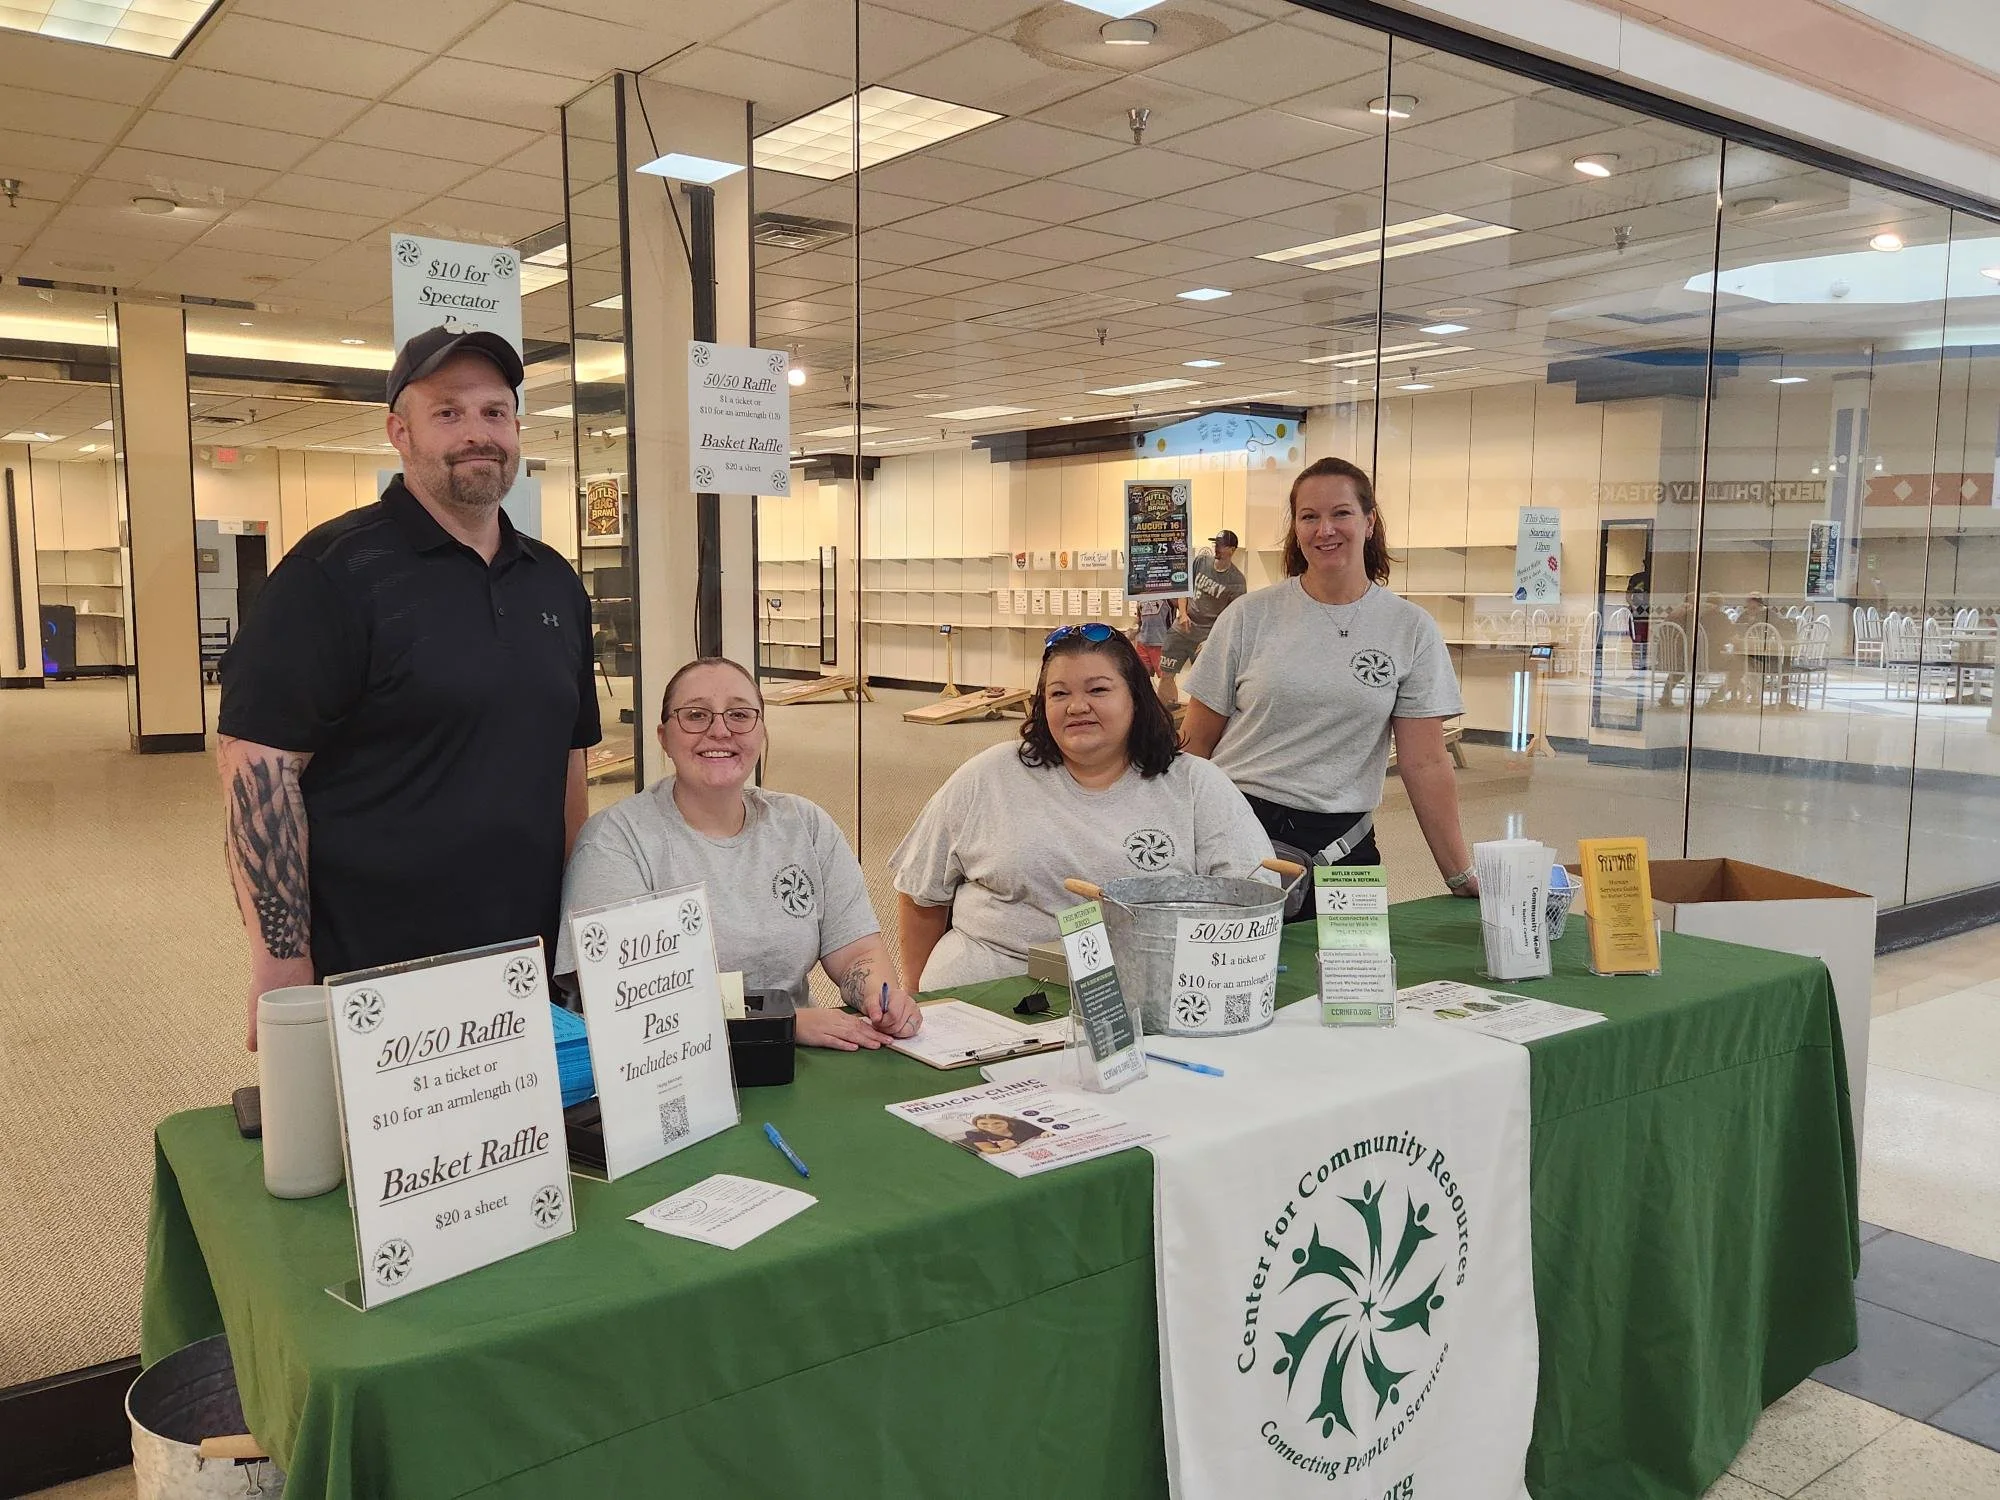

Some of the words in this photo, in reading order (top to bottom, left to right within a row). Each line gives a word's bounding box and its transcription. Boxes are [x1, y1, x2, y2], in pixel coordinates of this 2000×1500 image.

[428, 259, 461, 279] $10
[464, 265, 490, 282] for
[419, 286, 499, 309] Spectator
[704, 373, 740, 388] 50/50
[742, 376, 777, 392] Raffle
[720, 395, 728, 404] $1
[735, 397, 753, 406] ticket
[700, 406, 712, 414] $10
[714, 407, 723, 415] for
[735, 409, 767, 420] armlength
[701, 433, 745, 449] Basket
[749, 437, 783, 453] Raffle
[745, 464, 761, 472] sheet
[589, 487, 618, 505] BUTLER
[594, 498, 613, 510] BAG
[1145, 494, 1171, 503] BUTLER
[592, 508, 618, 519] BRAWL
[1156, 511, 1161, 520] 2
[1524, 513, 1538, 523] This
[601, 519, 607, 534] 2
[1136, 522, 1167, 530] AUGUST
[1170, 521, 1180, 529] 16
[1195, 572, 1226, 598] LUCKY
[1530, 886, 1540, 933] Community
[1190, 922, 1244, 943] 50/50
[1246, 915, 1280, 938] Raffle
[619, 933, 650, 966] $10
[655, 929, 680, 954] for
[1532, 934, 1541, 960] Meals
[1211, 952, 1226, 967] $1
[1237, 955, 1258, 965] ticket
[615, 968, 694, 1009] Spectator
[1178, 973, 1205, 988] $10
[1208, 980, 1221, 989] for
[1331, 1008, 1372, 1016] CCRINFO.ORG
[643, 1012, 679, 1039] Pass
[376, 1026, 450, 1068] 50/50
[456, 1011, 526, 1049] Raffle
[681, 1033, 712, 1061] Food
[413, 1075, 428, 1092] $1
[434, 1076, 442, 1087] a
[446, 1064, 481, 1083] ticket
[484, 1061, 498, 1072] or
[373, 1110, 399, 1131] $10
[403, 1106, 424, 1122] for
[427, 1102, 443, 1114] an
[447, 1082, 512, 1110] armlength
[515, 1072, 538, 1093] (13)
[906, 1093, 985, 1114] MEDICAL
[985, 1078, 1042, 1096] CLINIC
[381, 1152, 472, 1201] Basket
[478, 1126, 549, 1169] Raffle
[435, 1208, 460, 1230] $20
[464, 1210, 472, 1220] a
[475, 1195, 509, 1216] sheet
[1237, 1256, 1271, 1374] Center
[1264, 1201, 1298, 1252] for
[1298, 1130, 1428, 1199] Community
[1426, 1149, 1469, 1287] Resources
[1261, 1420, 1341, 1481] Connecting
[1343, 1436, 1389, 1475] People
[1391, 1421, 1405, 1442] to
[1405, 1342, 1449, 1423] Services
